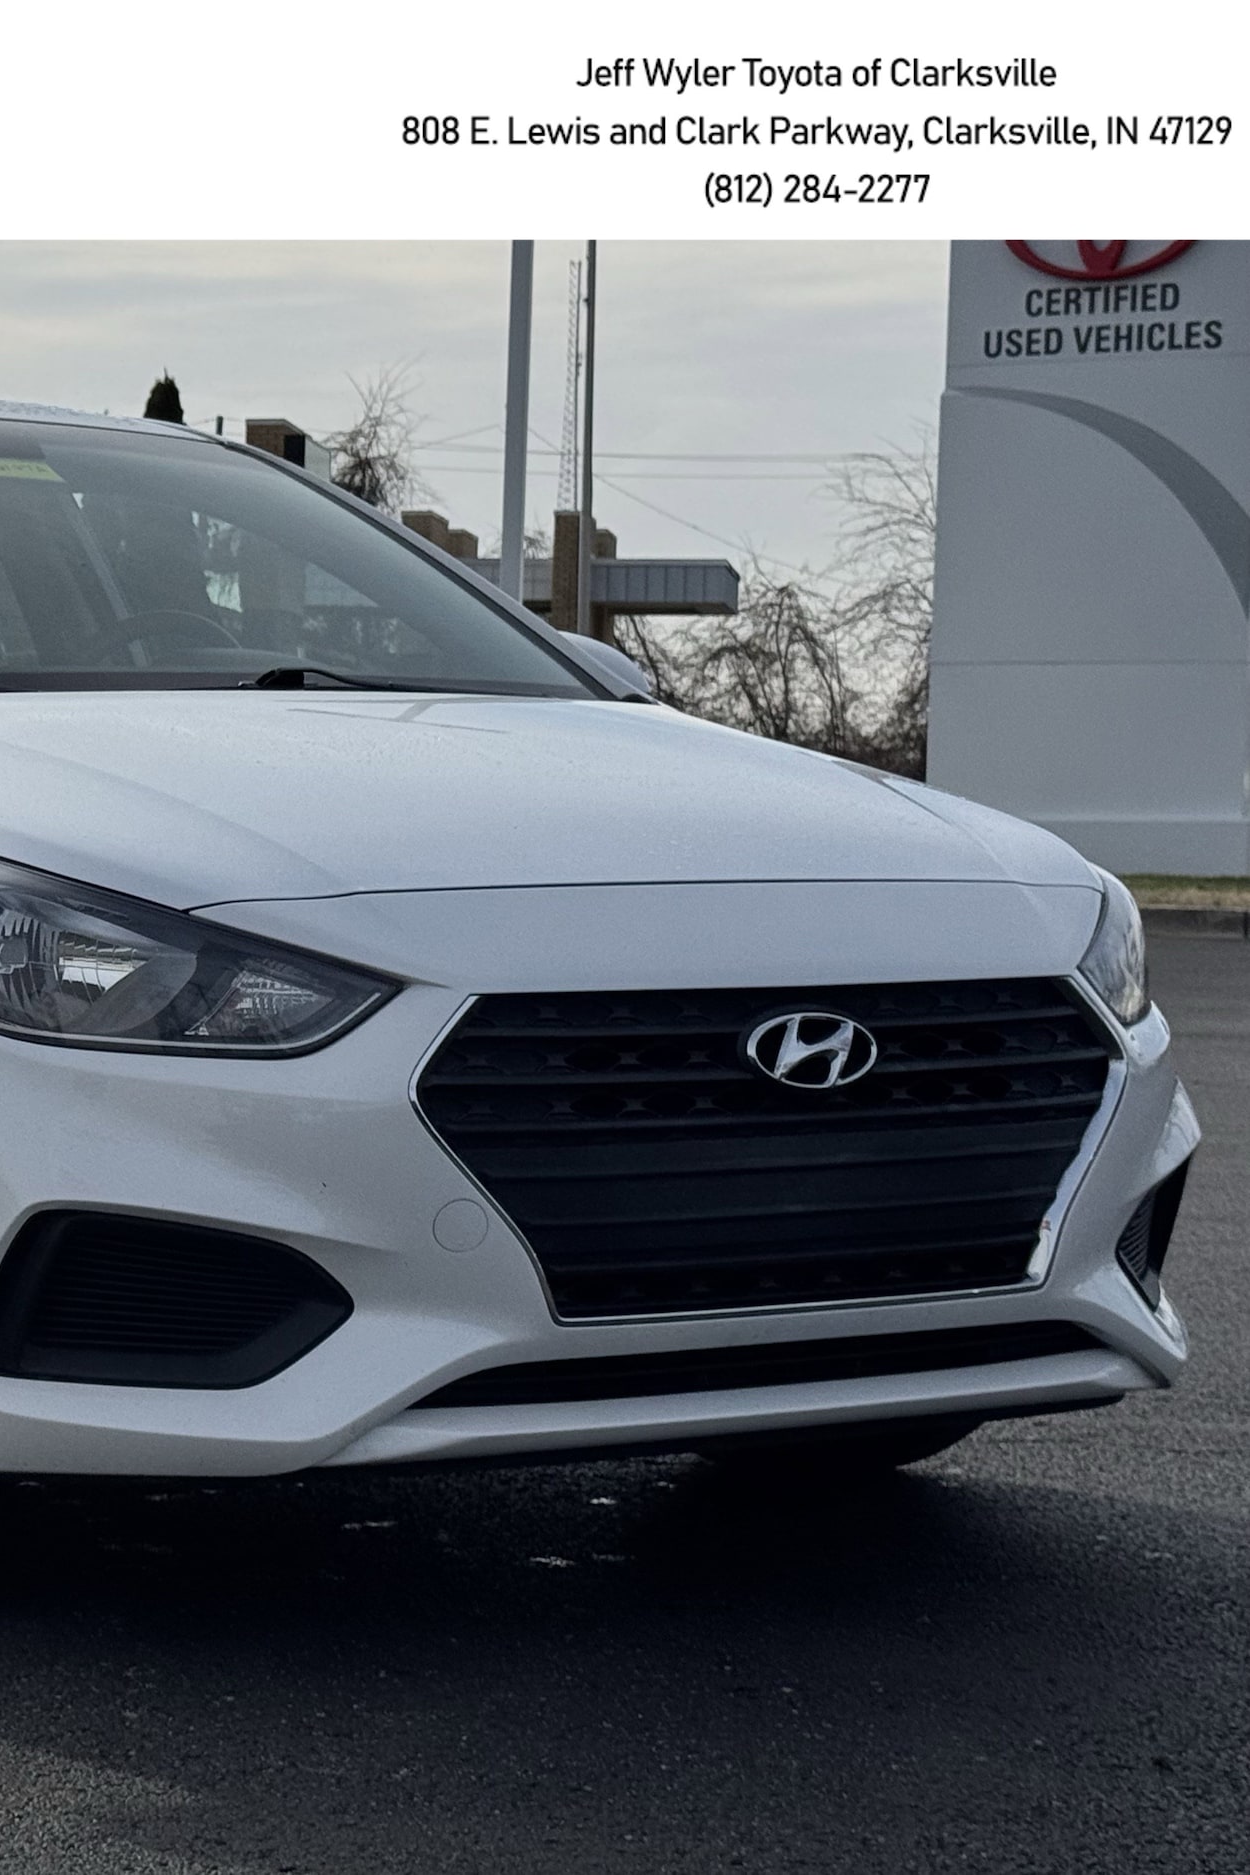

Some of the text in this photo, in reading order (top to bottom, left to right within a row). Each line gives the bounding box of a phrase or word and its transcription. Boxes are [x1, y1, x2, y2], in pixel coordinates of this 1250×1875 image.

[1025, 283, 1180, 318] CERTIFIED
[984, 320, 1223, 359] USED VEHICLES
